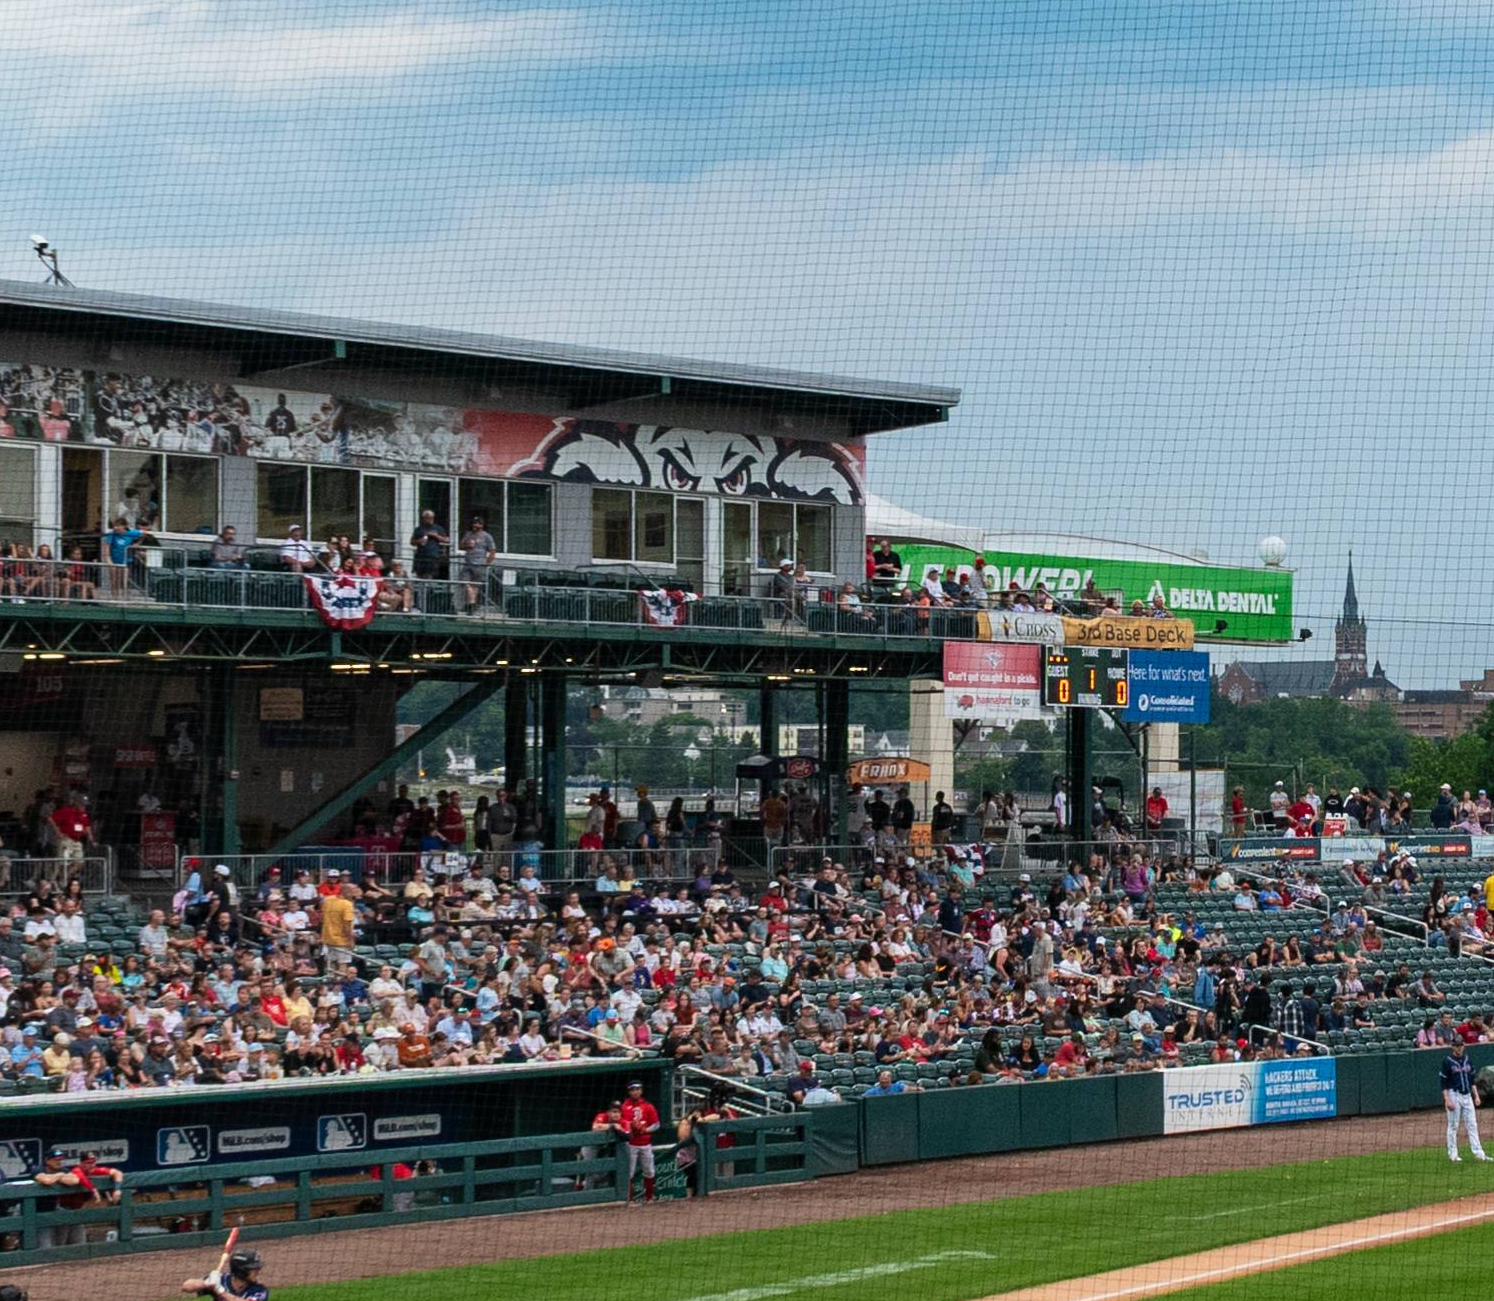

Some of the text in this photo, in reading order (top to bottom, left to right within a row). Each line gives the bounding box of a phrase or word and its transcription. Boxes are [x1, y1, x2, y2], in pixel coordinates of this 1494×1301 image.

[1169, 587, 1276, 614] DELTA DENTAL
[1076, 622, 1187, 644] 3rd Base Deck
[1148, 664, 1161, 680] for
[1161, 665, 1187, 681] what's
[1059, 679, 1070, 703] 0
[1116, 681, 1127, 705] 0
[1168, 1089, 1245, 1110] TRUSTED
[1170, 1106, 1242, 1123] INTERNET
